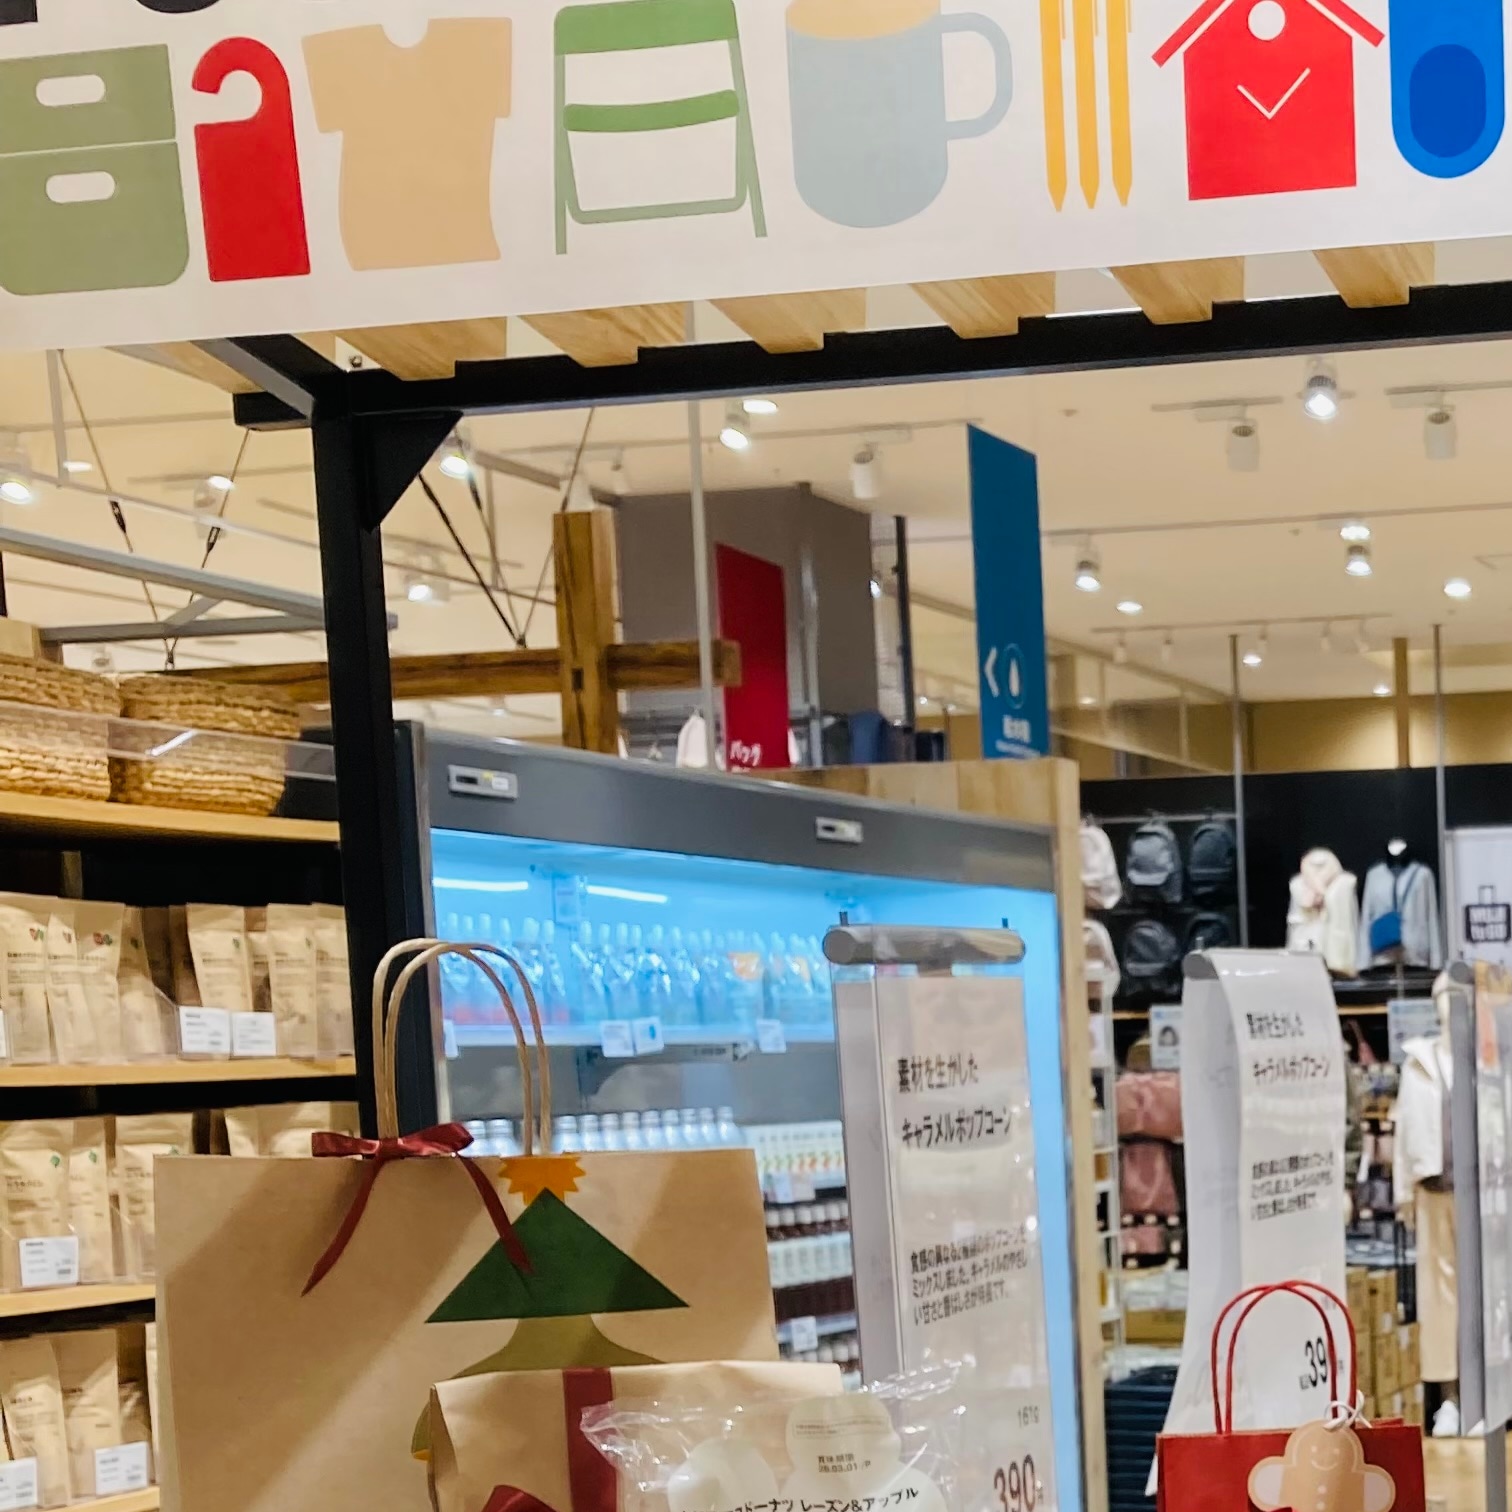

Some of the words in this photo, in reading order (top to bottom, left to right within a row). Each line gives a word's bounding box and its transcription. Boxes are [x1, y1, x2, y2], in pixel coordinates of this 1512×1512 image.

[902, 1106, 1012, 1149] キャラメルポップコーン
[1305, 1337, 1328, 1387] 39
[800, 1487, 919, 1512] レーズン&アップル
